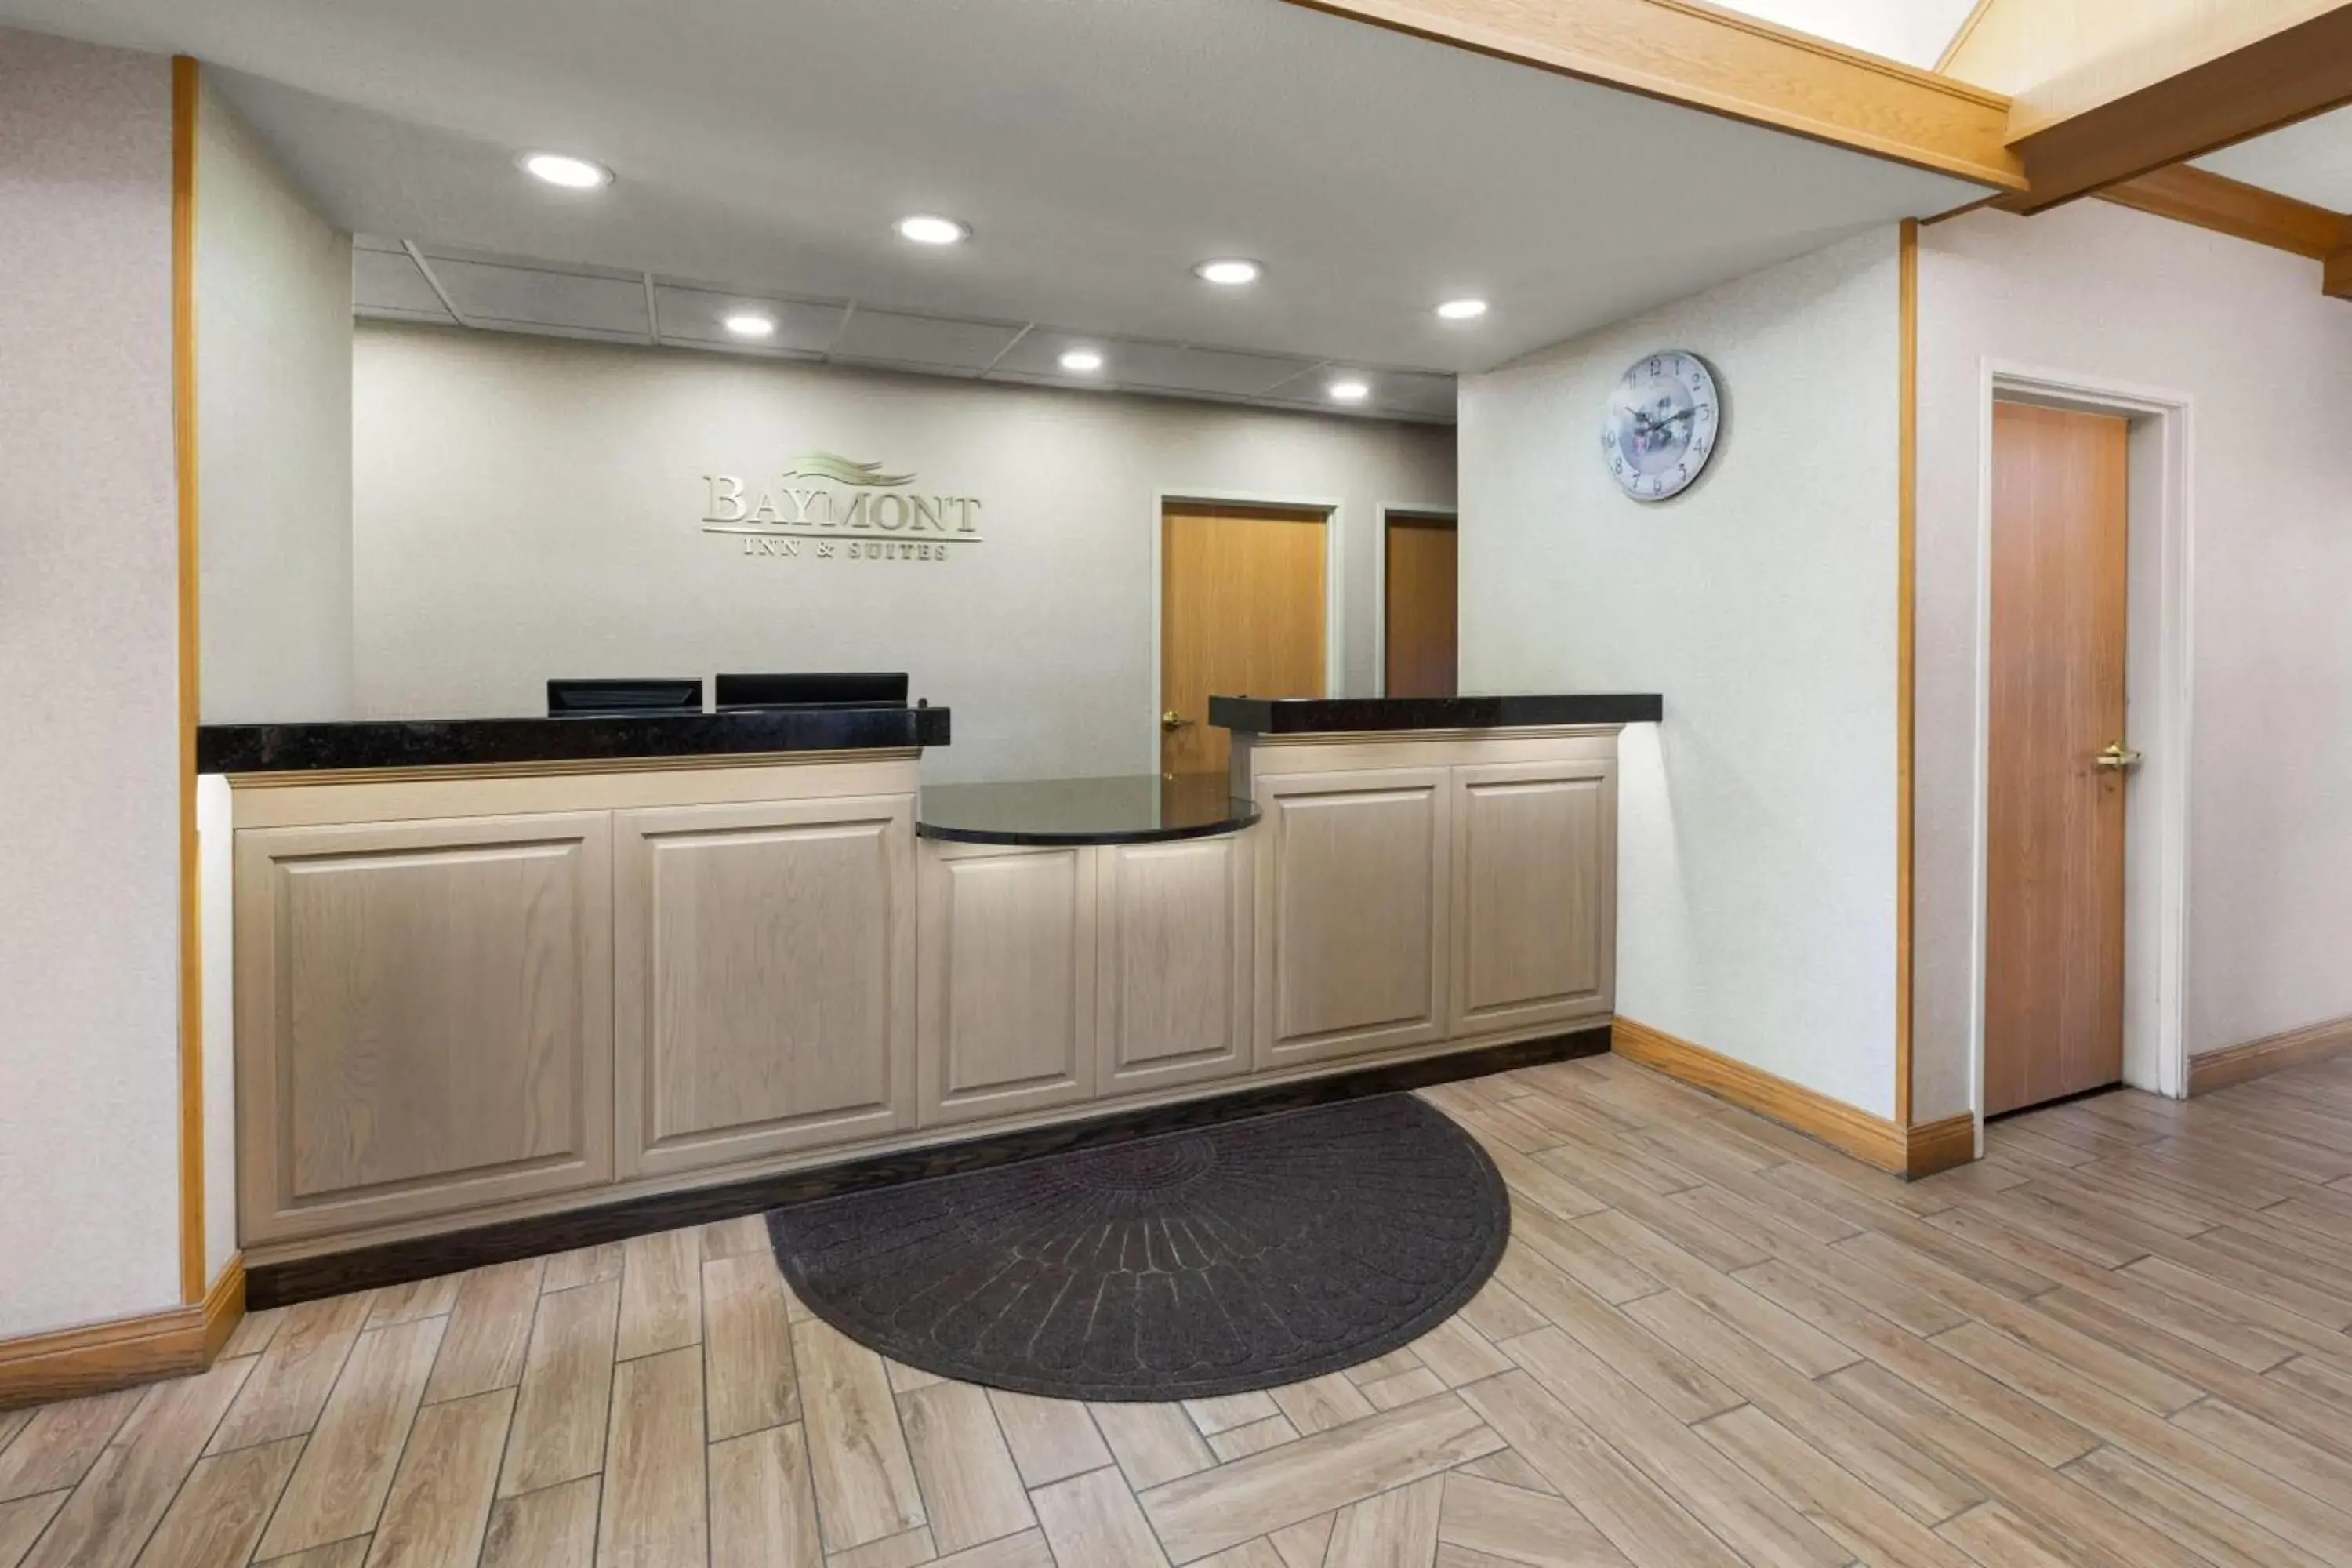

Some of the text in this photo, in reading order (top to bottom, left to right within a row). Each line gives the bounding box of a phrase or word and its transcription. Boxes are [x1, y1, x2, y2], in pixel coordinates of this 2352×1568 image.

[1650, 356, 1661, 376] 12
[702, 474, 982, 532] BAYMONT
[742, 538, 950, 561] INN & SUITES
